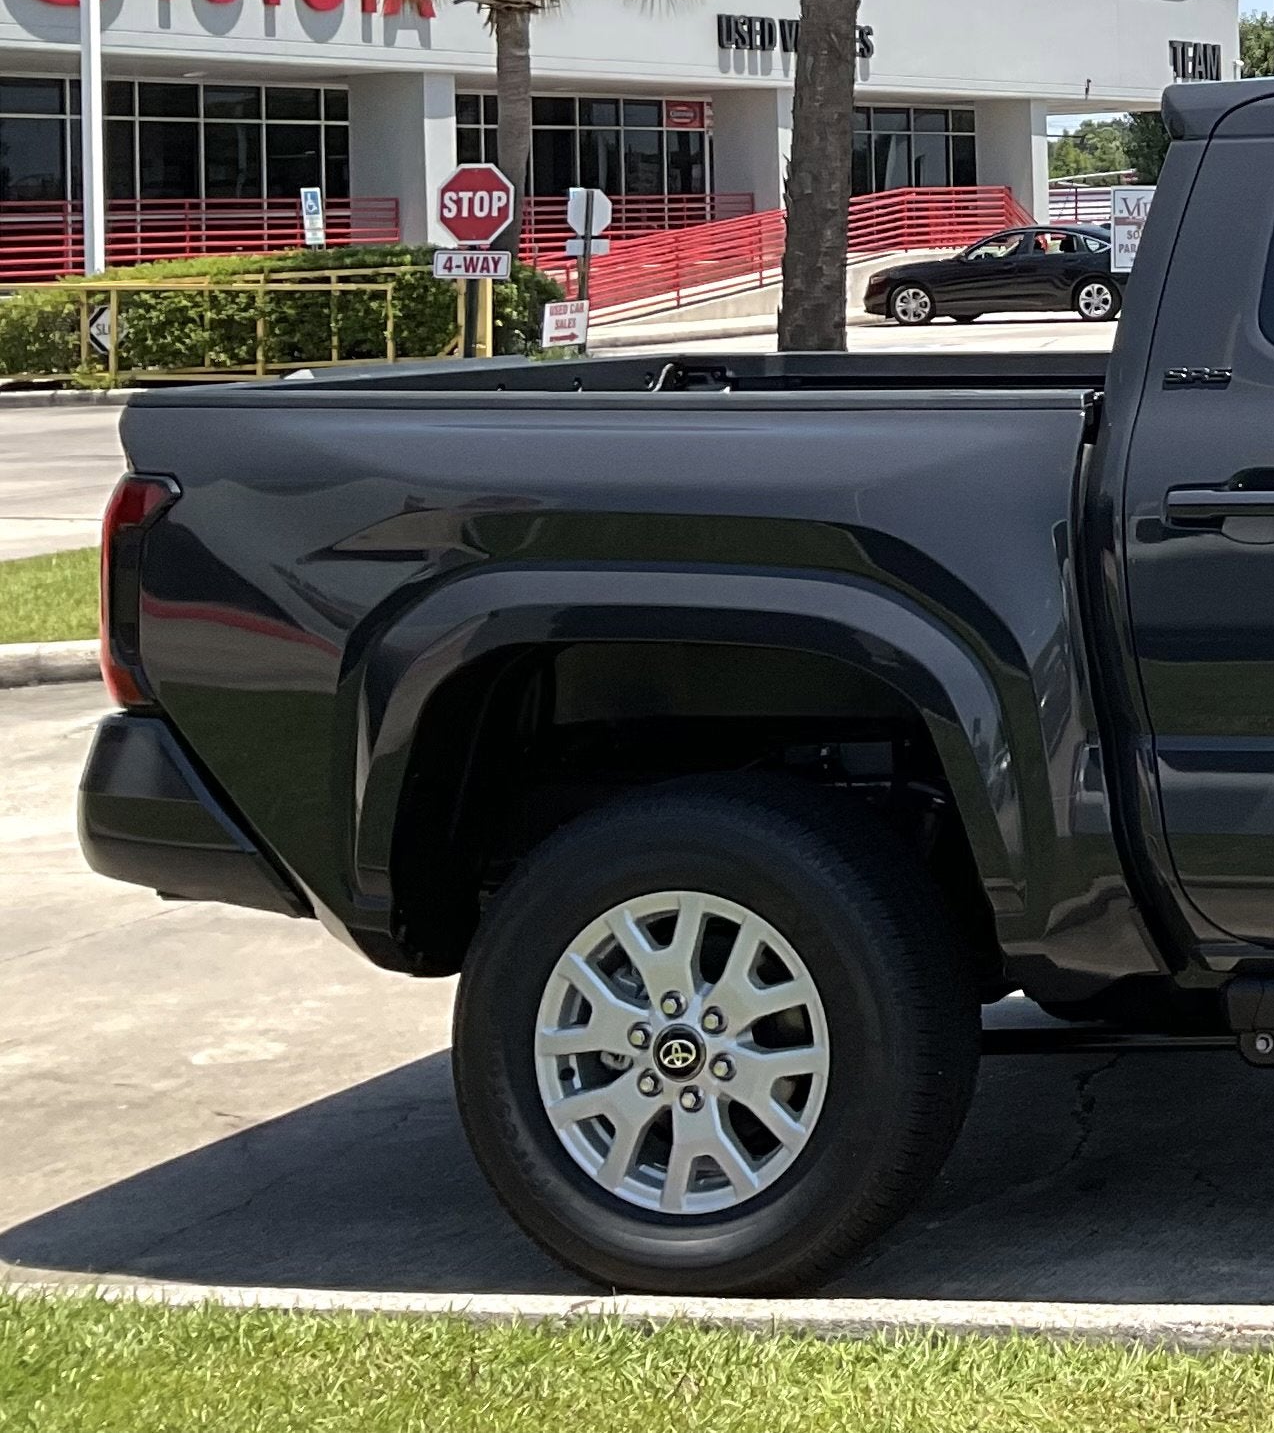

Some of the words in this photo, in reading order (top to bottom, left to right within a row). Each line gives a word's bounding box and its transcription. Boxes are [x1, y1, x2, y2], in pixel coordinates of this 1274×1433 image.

[717, 14, 777, 51] USED
[1169, 40, 1221, 81] TEAM
[442, 191, 507, 218] STOP
[1126, 229, 1141, 240] SO
[442, 256, 502, 274] 4-WAY
